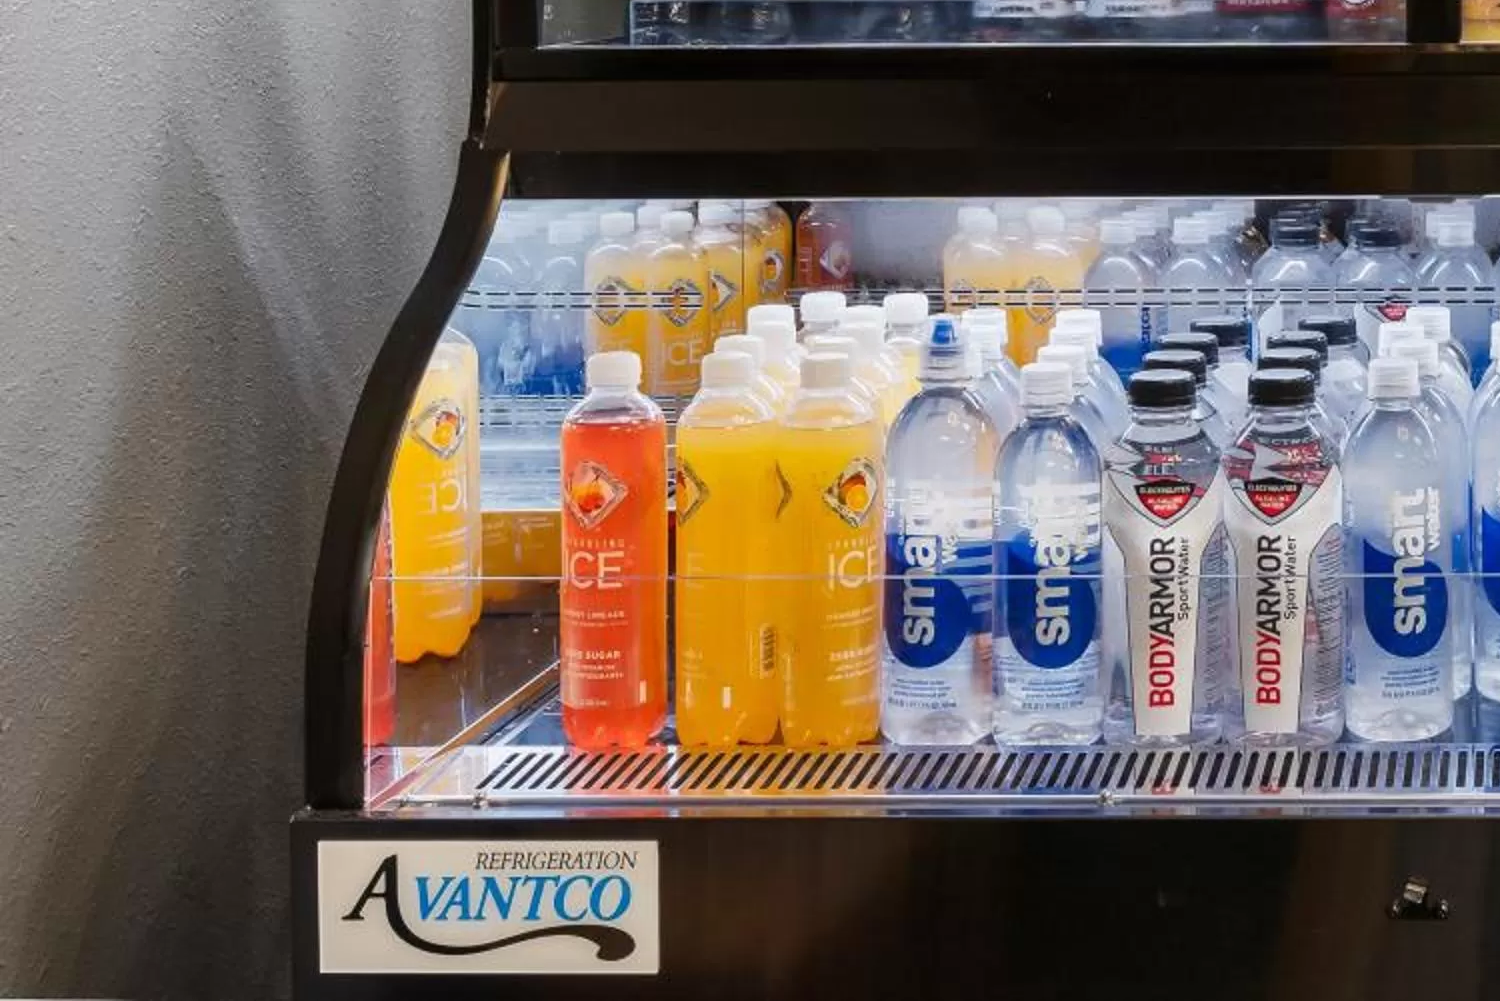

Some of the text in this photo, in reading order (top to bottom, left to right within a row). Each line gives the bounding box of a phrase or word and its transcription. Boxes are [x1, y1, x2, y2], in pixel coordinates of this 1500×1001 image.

[585, 650, 621, 661] SUGAR
[1149, 536, 1176, 708] BODYARMOR
[1256, 534, 1282, 705] BODYARMOR
[474, 850, 638, 871] REFRIGERATION
